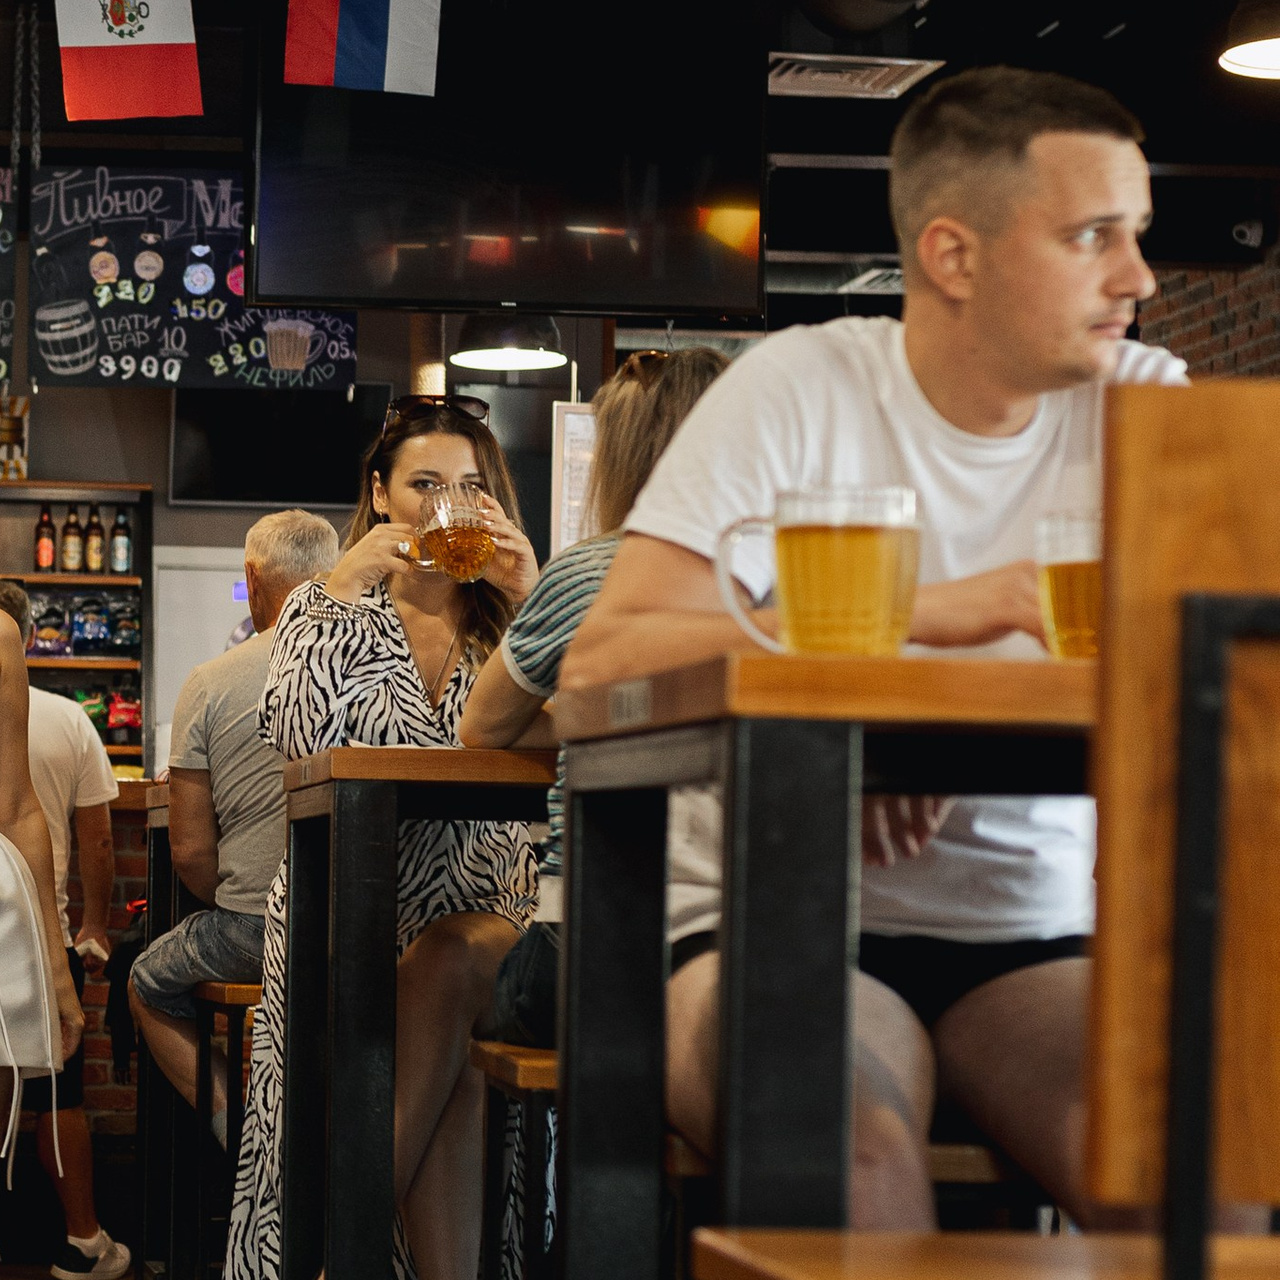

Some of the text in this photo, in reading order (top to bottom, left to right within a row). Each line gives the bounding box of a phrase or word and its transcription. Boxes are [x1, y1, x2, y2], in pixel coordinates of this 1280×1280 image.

[32, 166, 171, 235] Пивное
[192, 178, 245, 229] Ме
[101, 313, 161, 334] ПАТИ
[107, 331, 150, 353] БАР
[158, 326, 186, 352] 10
[98, 354, 182, 383] 3900
